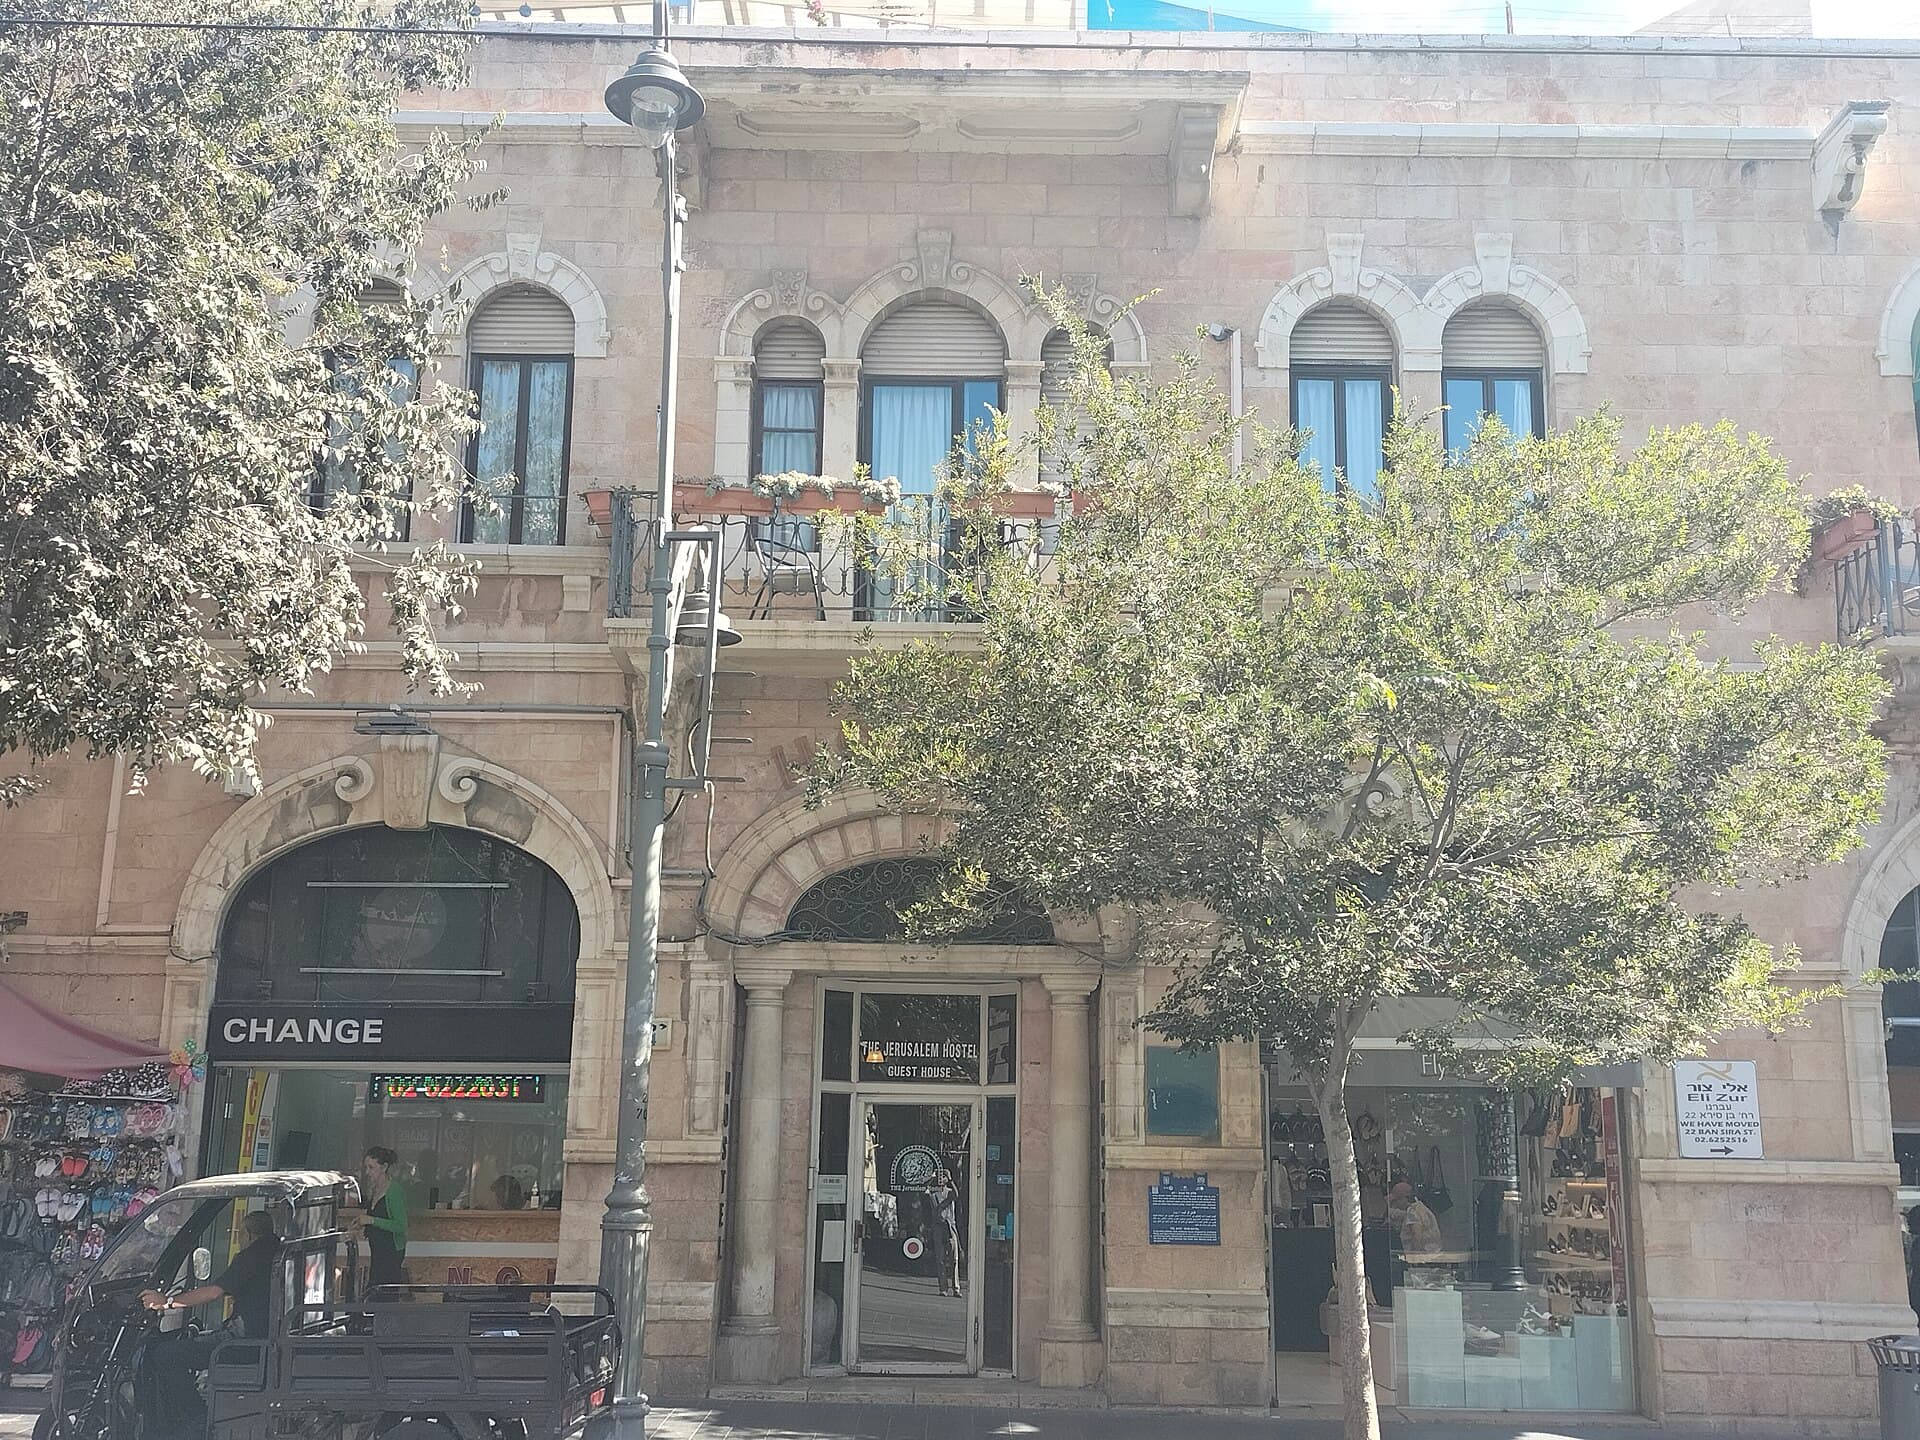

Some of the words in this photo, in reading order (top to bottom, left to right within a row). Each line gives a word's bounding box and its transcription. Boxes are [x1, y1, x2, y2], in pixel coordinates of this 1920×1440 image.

[223, 1018, 383, 1044] CHANGE
[861, 1040, 881, 1056] THE
[883, 1041, 939, 1058] JERUSALEM
[942, 1043, 978, 1059] HOSTEL
[887, 1066, 918, 1077] GUEST
[920, 1067, 951, 1078] HOUSE
[1686, 1084, 1713, 1092] צור
[1722, 1083, 1748, 1093] אלי
[1687, 1093, 1710, 1102] Eli
[1716, 1093, 1748, 1102] Zur
[1705, 1103, 1732, 1111] עברנו
[1725, 1112, 1736, 1120] בן
